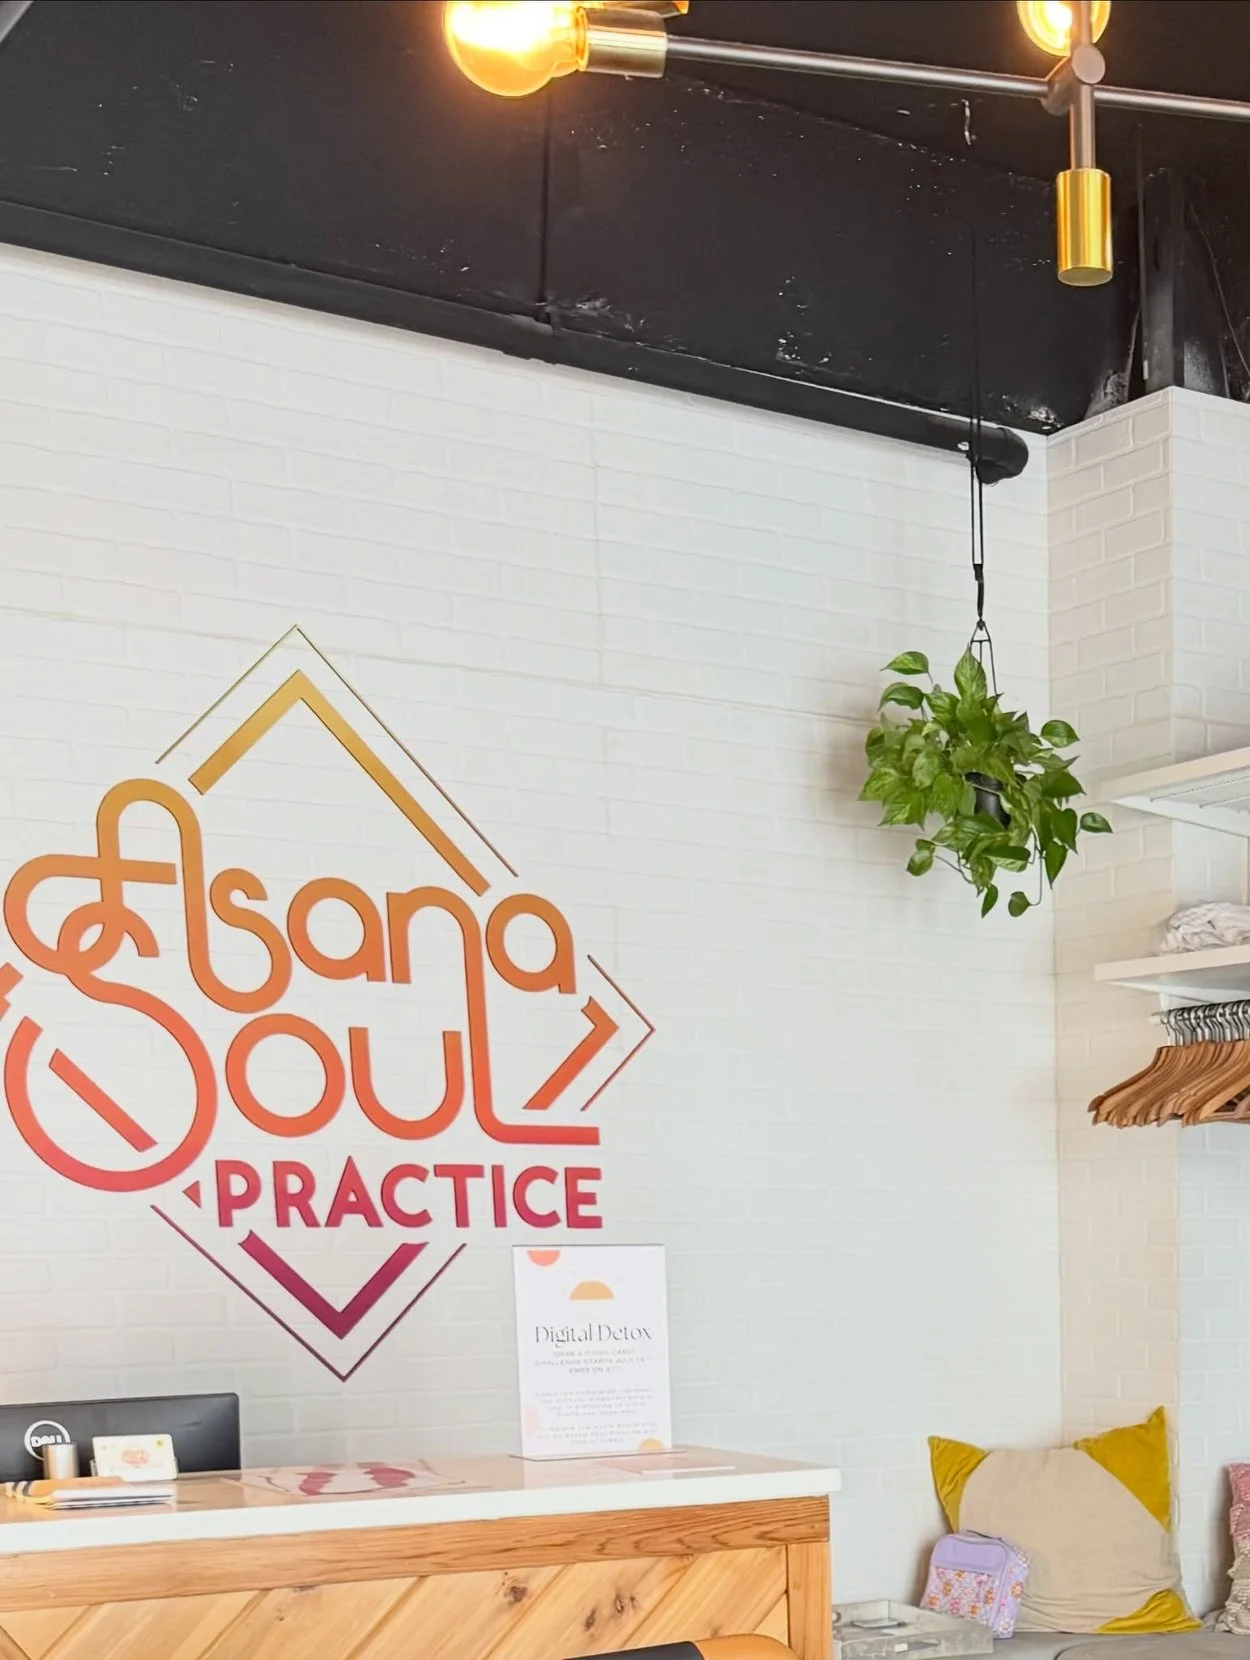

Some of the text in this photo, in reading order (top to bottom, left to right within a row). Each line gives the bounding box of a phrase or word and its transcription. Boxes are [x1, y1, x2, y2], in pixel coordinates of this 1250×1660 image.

[4, 779, 577, 1013] Asana
[215, 1156, 602, 1229] PRACTICE
[535, 1323, 652, 1348] Digital Detox
